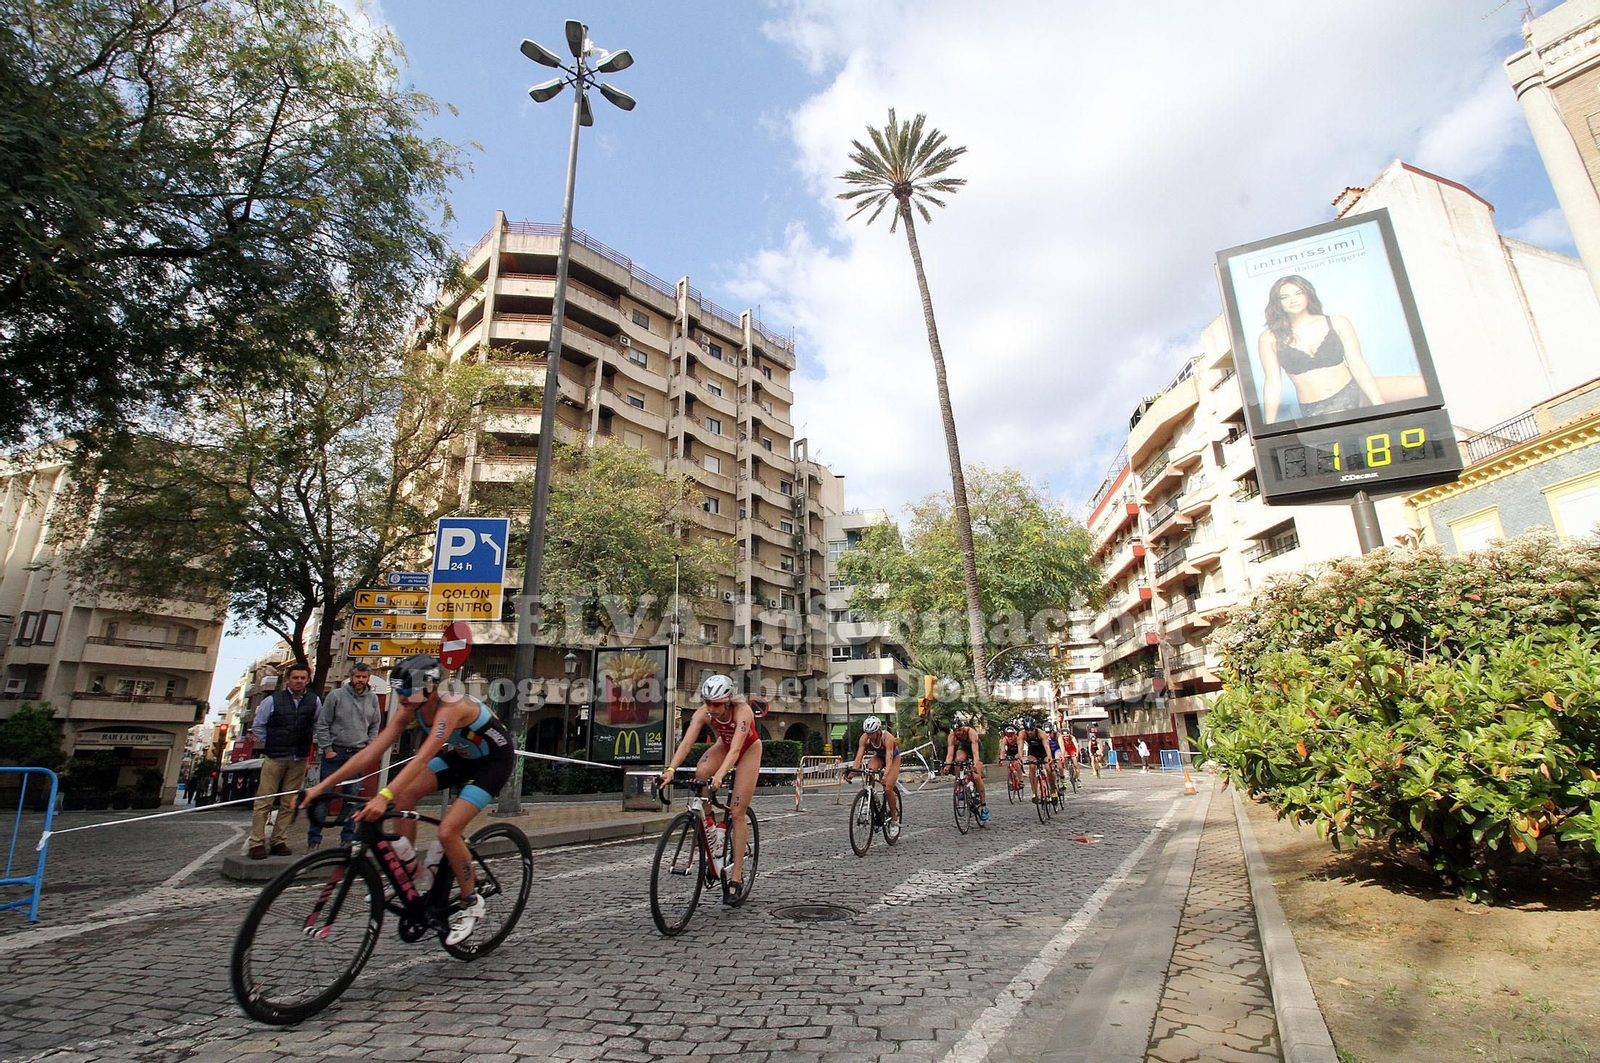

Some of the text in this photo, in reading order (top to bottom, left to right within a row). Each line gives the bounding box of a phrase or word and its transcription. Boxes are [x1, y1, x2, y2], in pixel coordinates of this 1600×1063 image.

[1253, 239, 1356, 271] intimissimi
[1328, 251, 1367, 265] lingerie
[1339, 472, 1380, 482] JCDecaux
[437, 527, 477, 570] P
[450, 562, 473, 571] 24 h
[442, 586, 490, 599] COLÓN
[436, 602, 493, 613] CENTRO
[386, 622, 417, 630] Familia
[648, 732, 662, 742] 24
